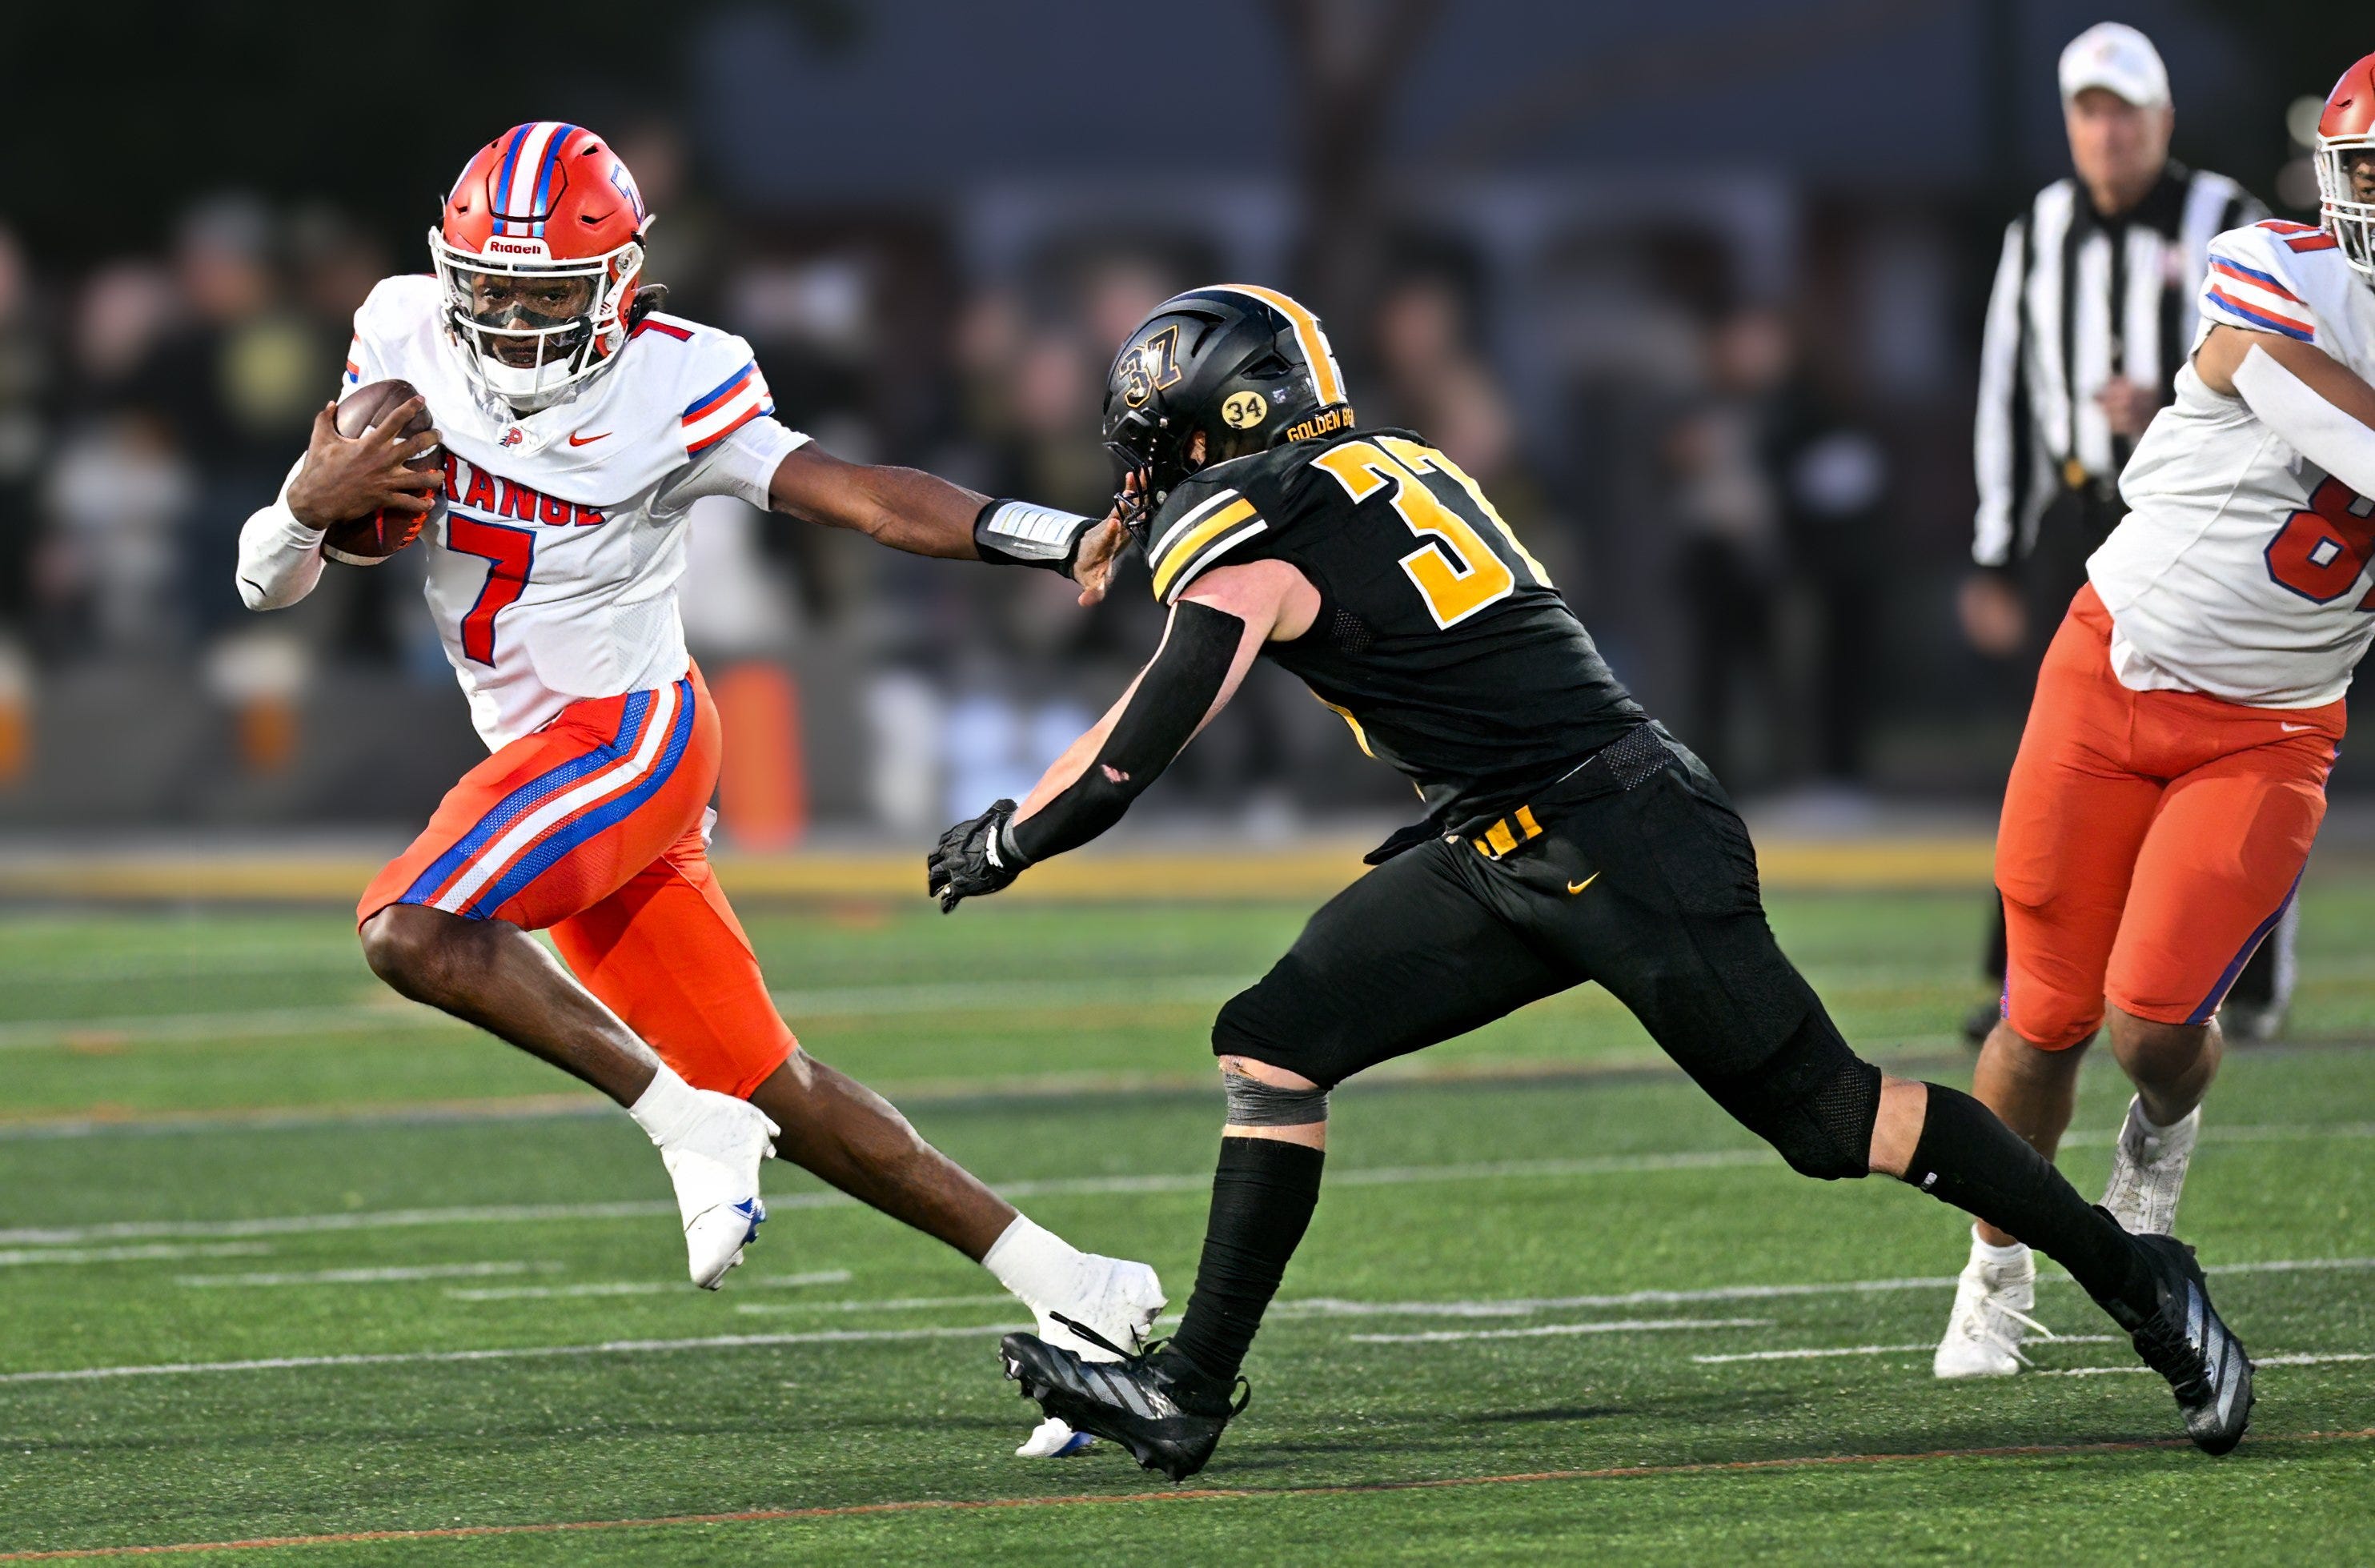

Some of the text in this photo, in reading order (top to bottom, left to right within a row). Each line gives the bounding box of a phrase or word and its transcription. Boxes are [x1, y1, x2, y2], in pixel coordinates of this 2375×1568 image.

[490, 241, 541, 255] Riddell
[1119, 324, 1182, 408] 37
[1227, 396, 1262, 428] 34
[1286, 409, 1341, 443] GOLDEN
[443, 453, 607, 527] RANG
[1310, 435, 1555, 631] 37
[2264, 474, 2375, 613] 8
[447, 510, 537, 669] 7
